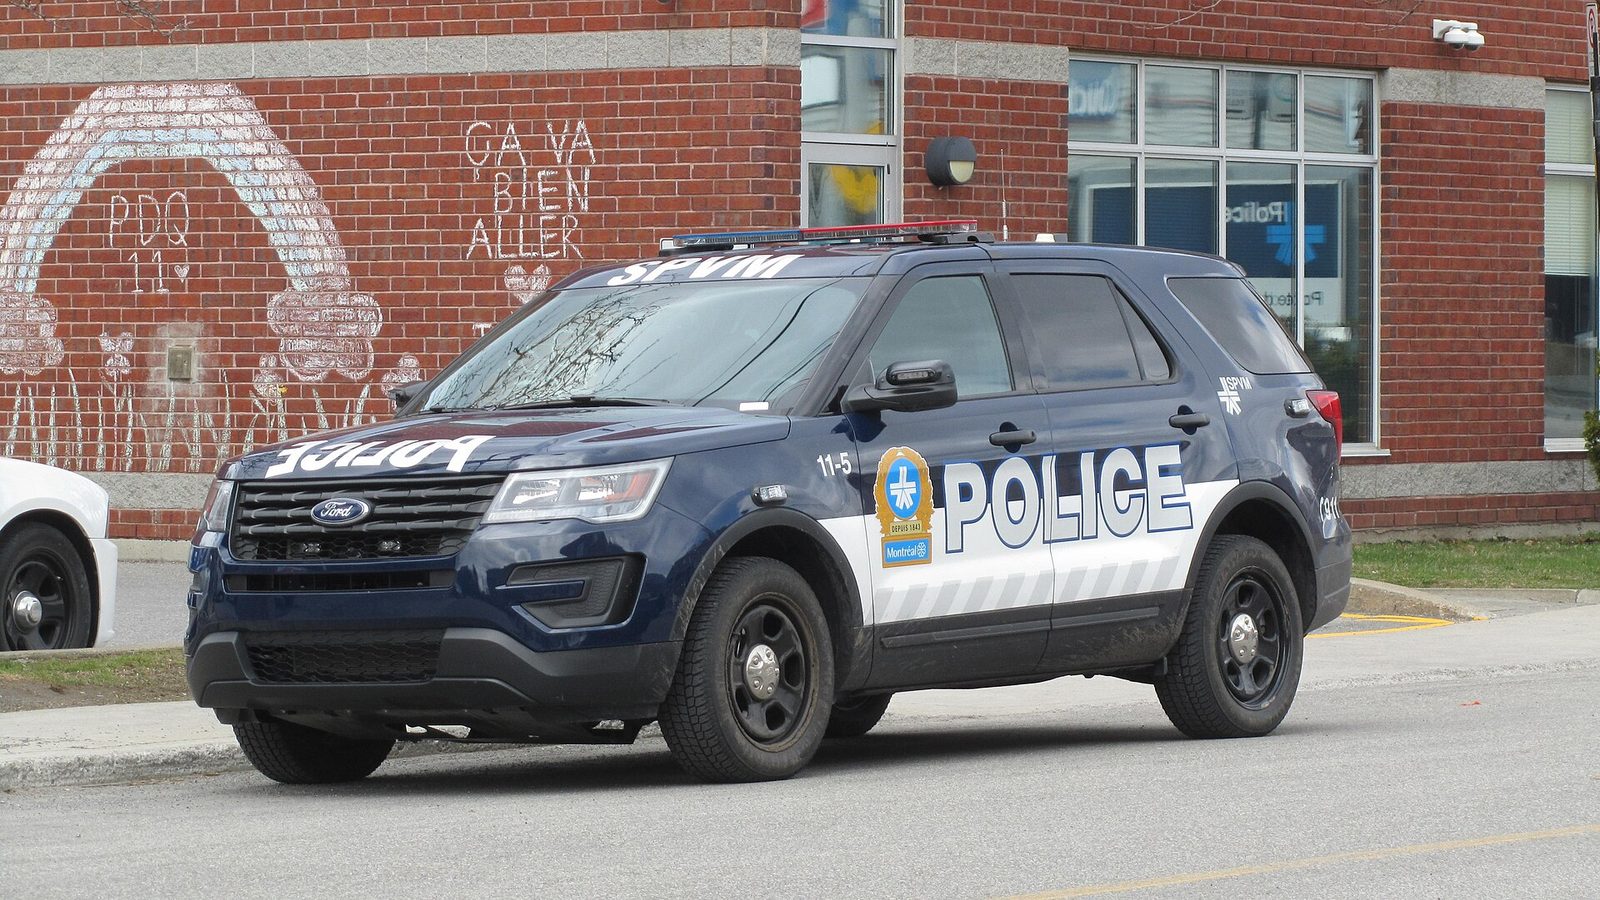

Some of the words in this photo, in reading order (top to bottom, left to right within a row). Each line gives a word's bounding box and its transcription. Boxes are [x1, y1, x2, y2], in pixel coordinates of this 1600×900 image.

[546, 119, 596, 164] VA
[494, 166, 590, 213] BIEN
[110, 191, 189, 247] PDQ
[466, 214, 584, 259] ALLER
[128, 251, 170, 293] 11
[607, 254, 805, 286] SPVM
[1227, 376, 1252, 390] SPVM
[817, 452, 852, 477] 11-5
[320, 501, 354, 517] Ford
[944, 443, 1194, 554] POLICE
[892, 524, 909, 533] DEPUIS
[887, 545, 917, 559] Montréal
